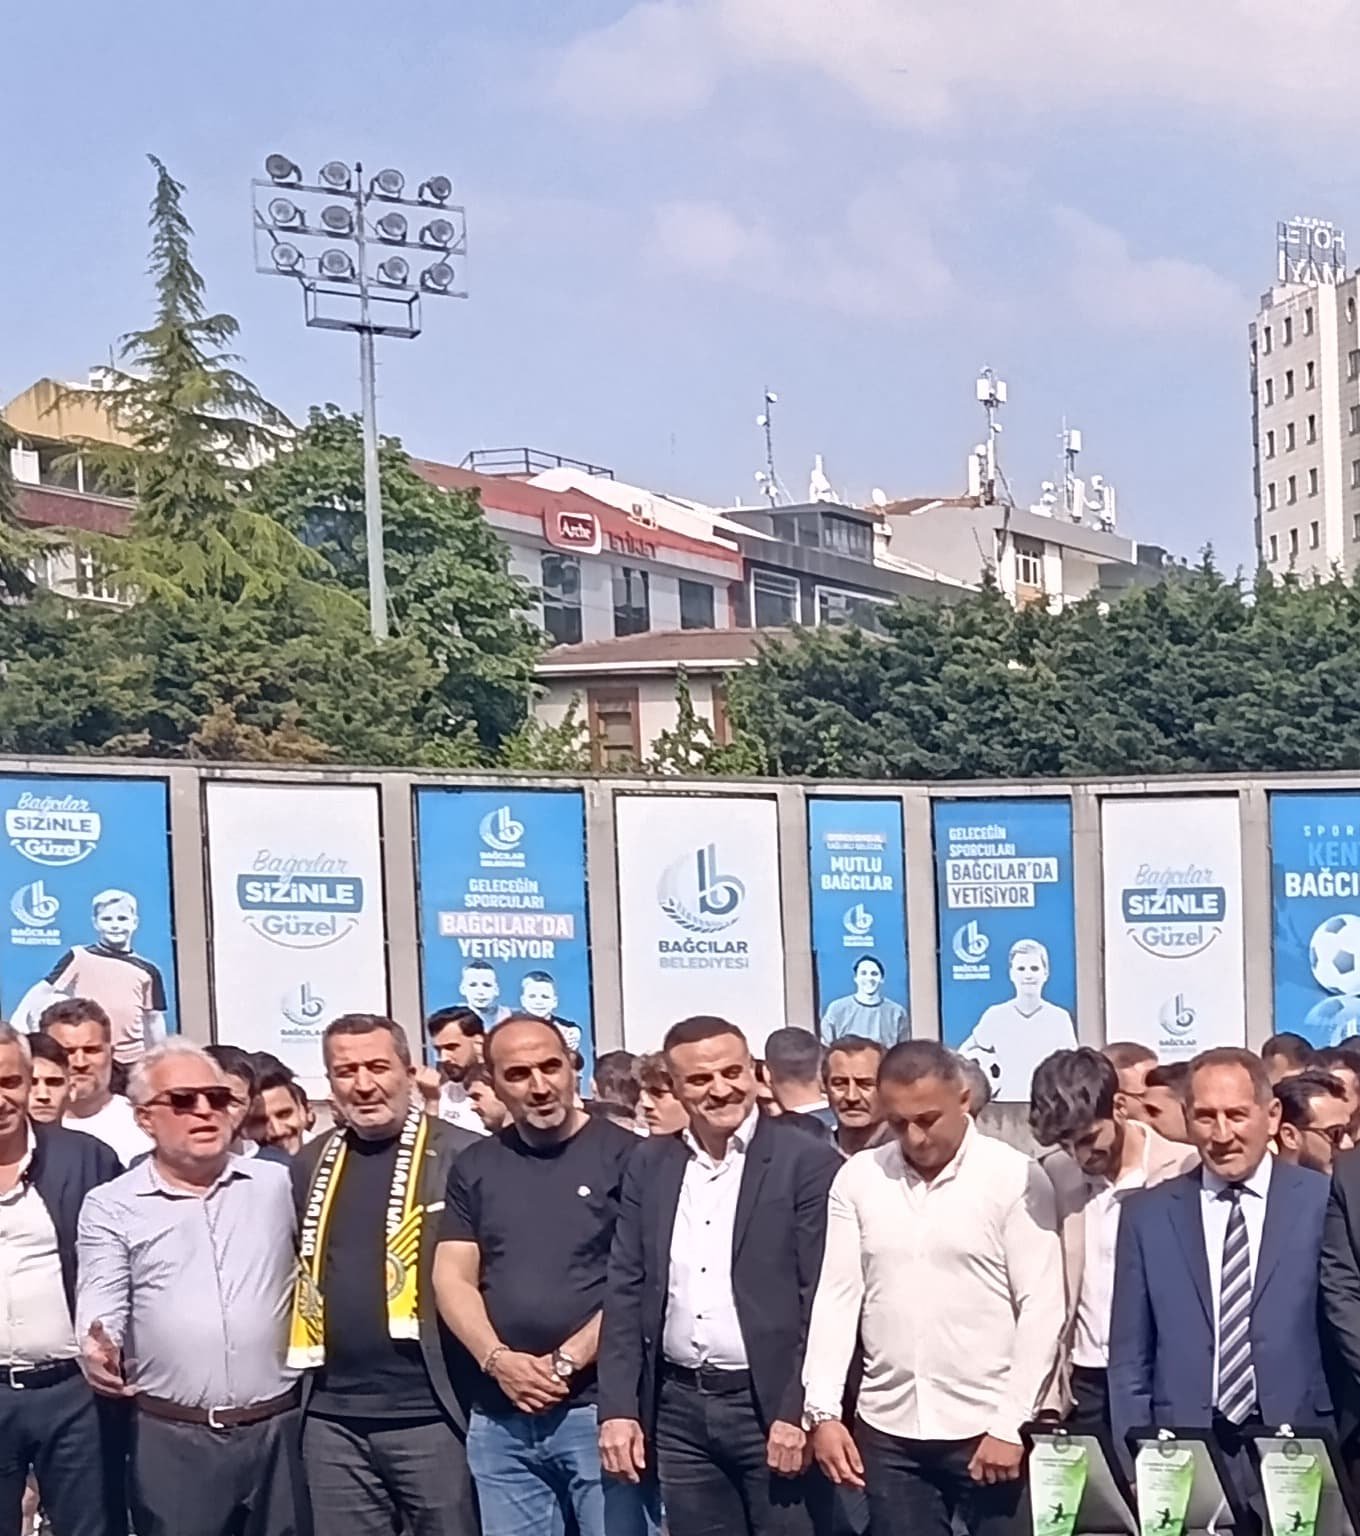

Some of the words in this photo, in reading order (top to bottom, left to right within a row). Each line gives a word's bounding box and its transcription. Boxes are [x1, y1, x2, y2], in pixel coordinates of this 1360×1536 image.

[14, 816, 92, 833] SİZİNLE
[25, 838, 81, 857] Güzel
[830, 856, 882, 873] MUTLU
[951, 859, 1053, 881] BAĞCILAR'DA
[469, 876, 539, 894] GELECEĞİN
[821, 871, 893, 891] BAĞCILAR
[245, 881, 355, 905] SİZİNLE
[464, 894, 545, 909] SPORCULARI
[952, 885, 1029, 907] YETİŞİYOR
[1128, 893, 1219, 916] SİZİNLE
[262, 914, 337, 937] Güzel
[441, 911, 570, 936] BAĞCILAR'DA
[658, 937, 749, 954] BAĞCILAR
[1142, 925, 1204, 947] Güzel
[458, 937, 555, 963] YETİŞİYOR
[659, 956, 749, 970] BELEDİYESİ
